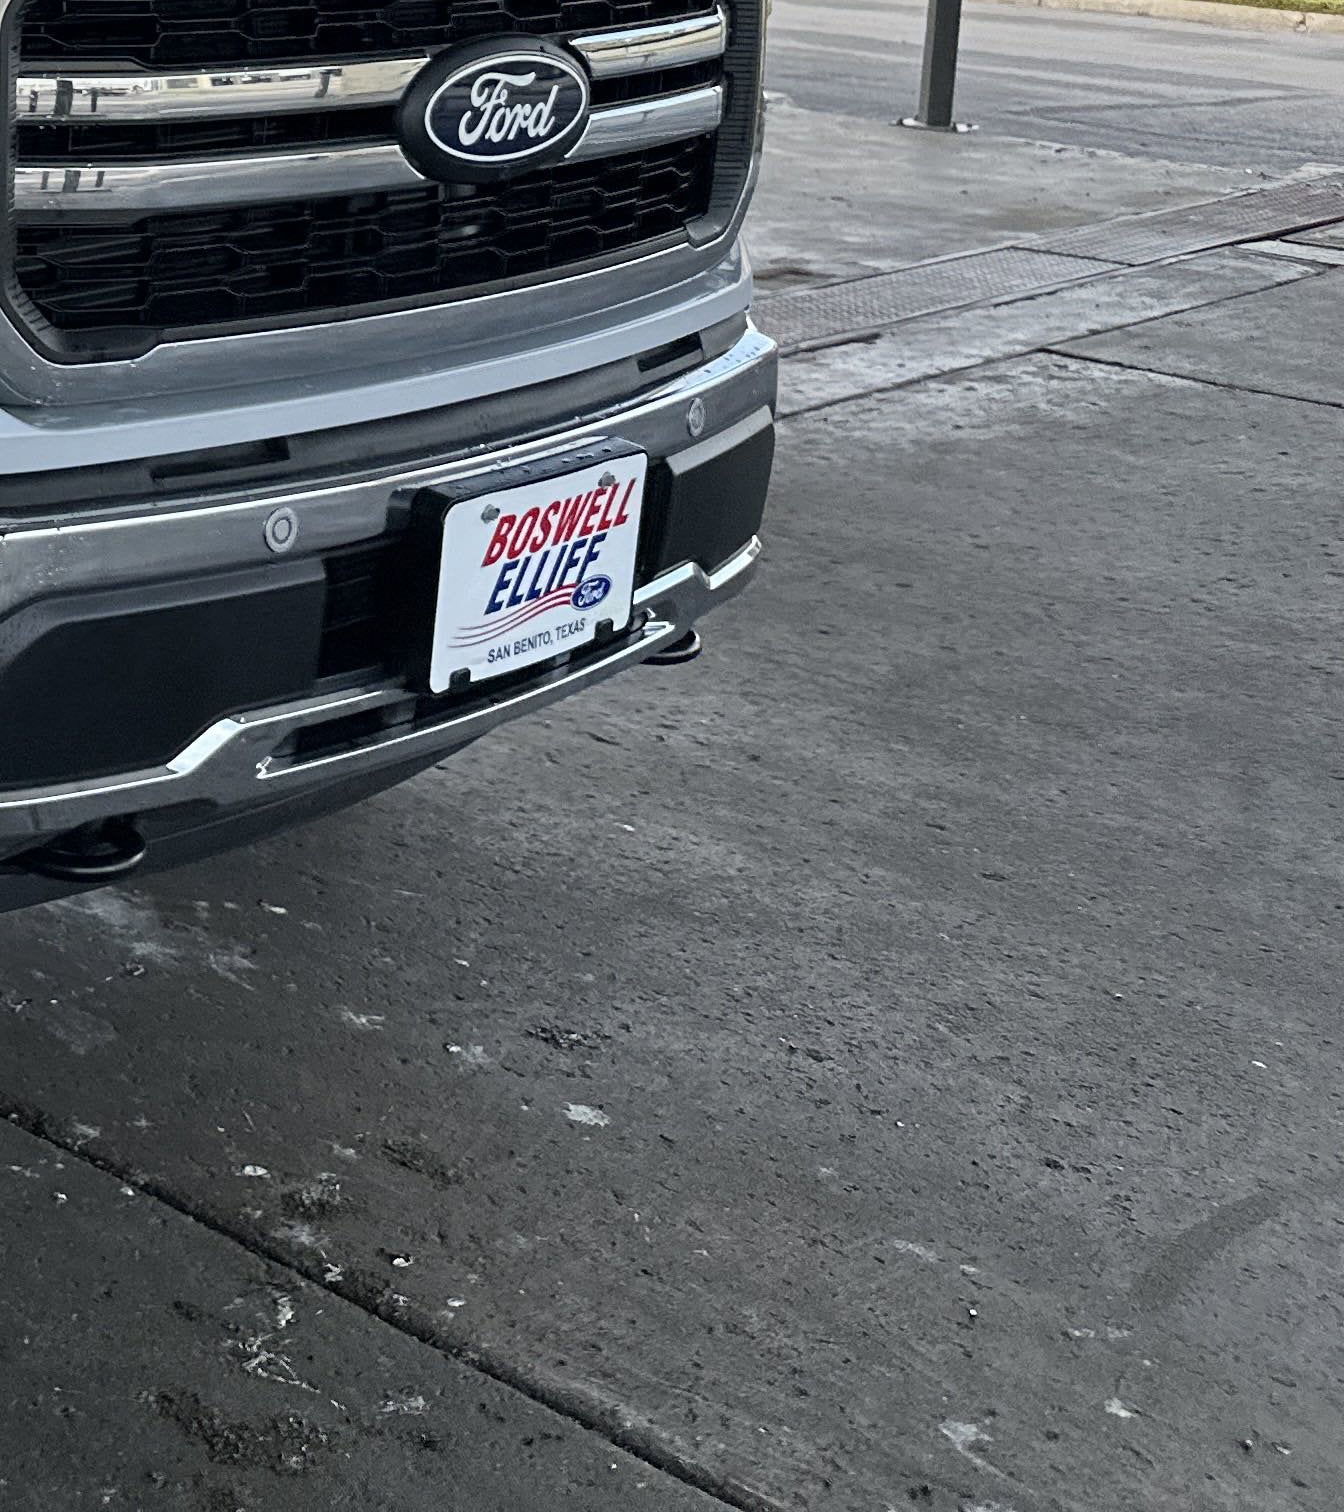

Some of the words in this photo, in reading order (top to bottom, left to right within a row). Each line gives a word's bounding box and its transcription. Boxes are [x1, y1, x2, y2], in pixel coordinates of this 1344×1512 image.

[458, 71, 560, 146] Ford
[482, 479, 635, 567] BOSWELL
[484, 532, 607, 615] ELLIFF
[577, 578, 608, 607] Ford
[487, 647, 510, 663] SAN
[513, 631, 554, 657] BENITO,
[556, 618, 585, 640] TEXAS
